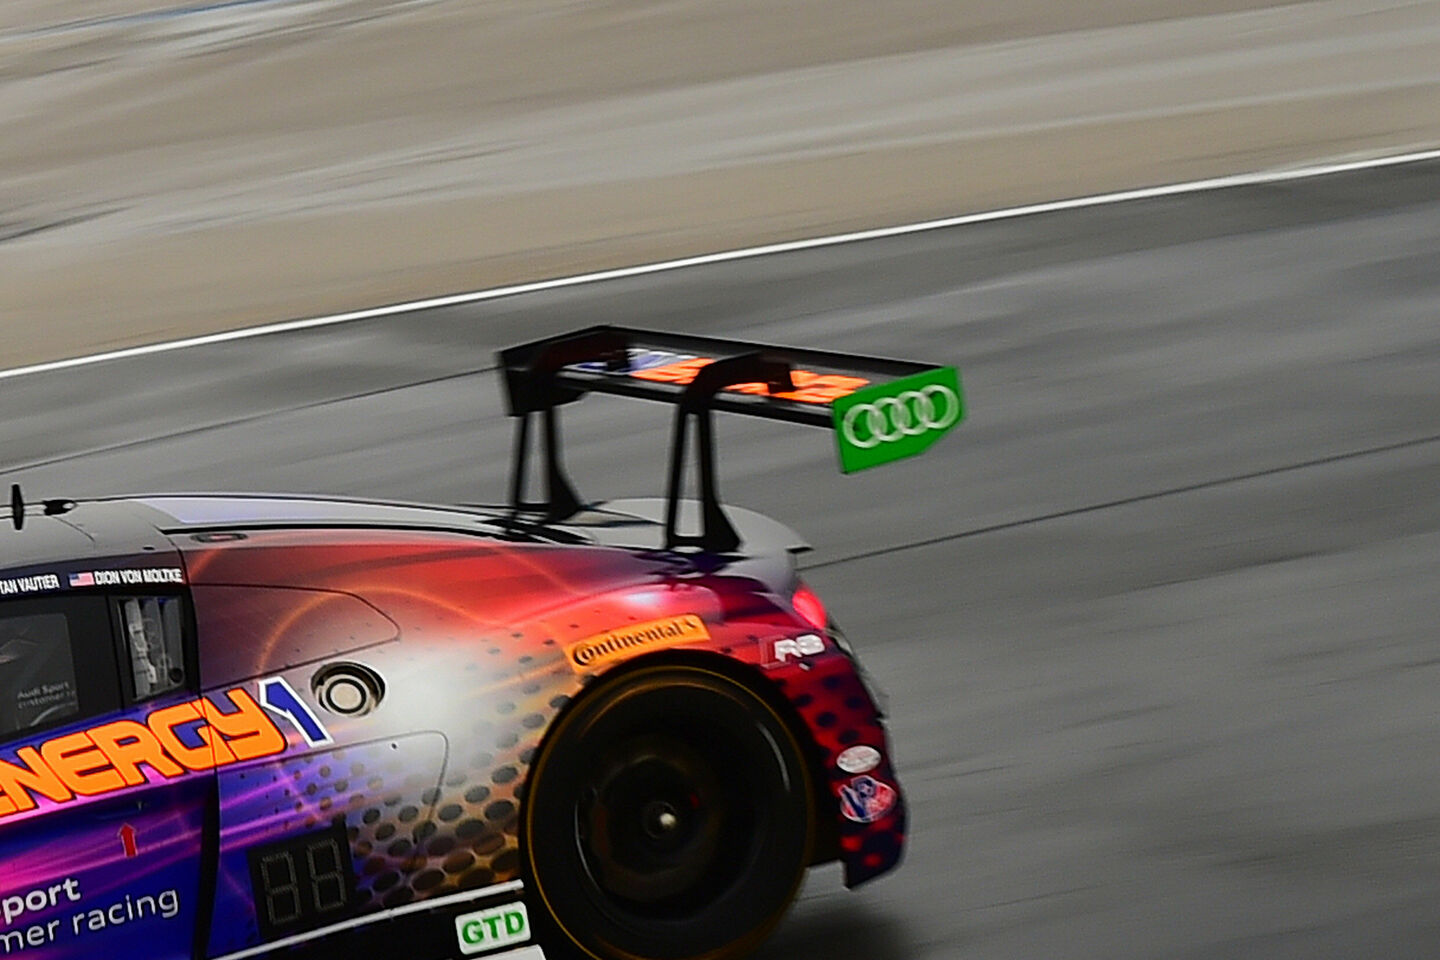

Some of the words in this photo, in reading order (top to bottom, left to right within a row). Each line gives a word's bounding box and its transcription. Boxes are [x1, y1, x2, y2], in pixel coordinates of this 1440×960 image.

[19, 574, 59, 592] VAUTIER
[94, 570, 120, 585] DION
[121, 569, 143, 584] VON
[572, 620, 683, 667] Continental
[71, 888, 180, 935] racing
[460, 909, 525, 947] GTD
